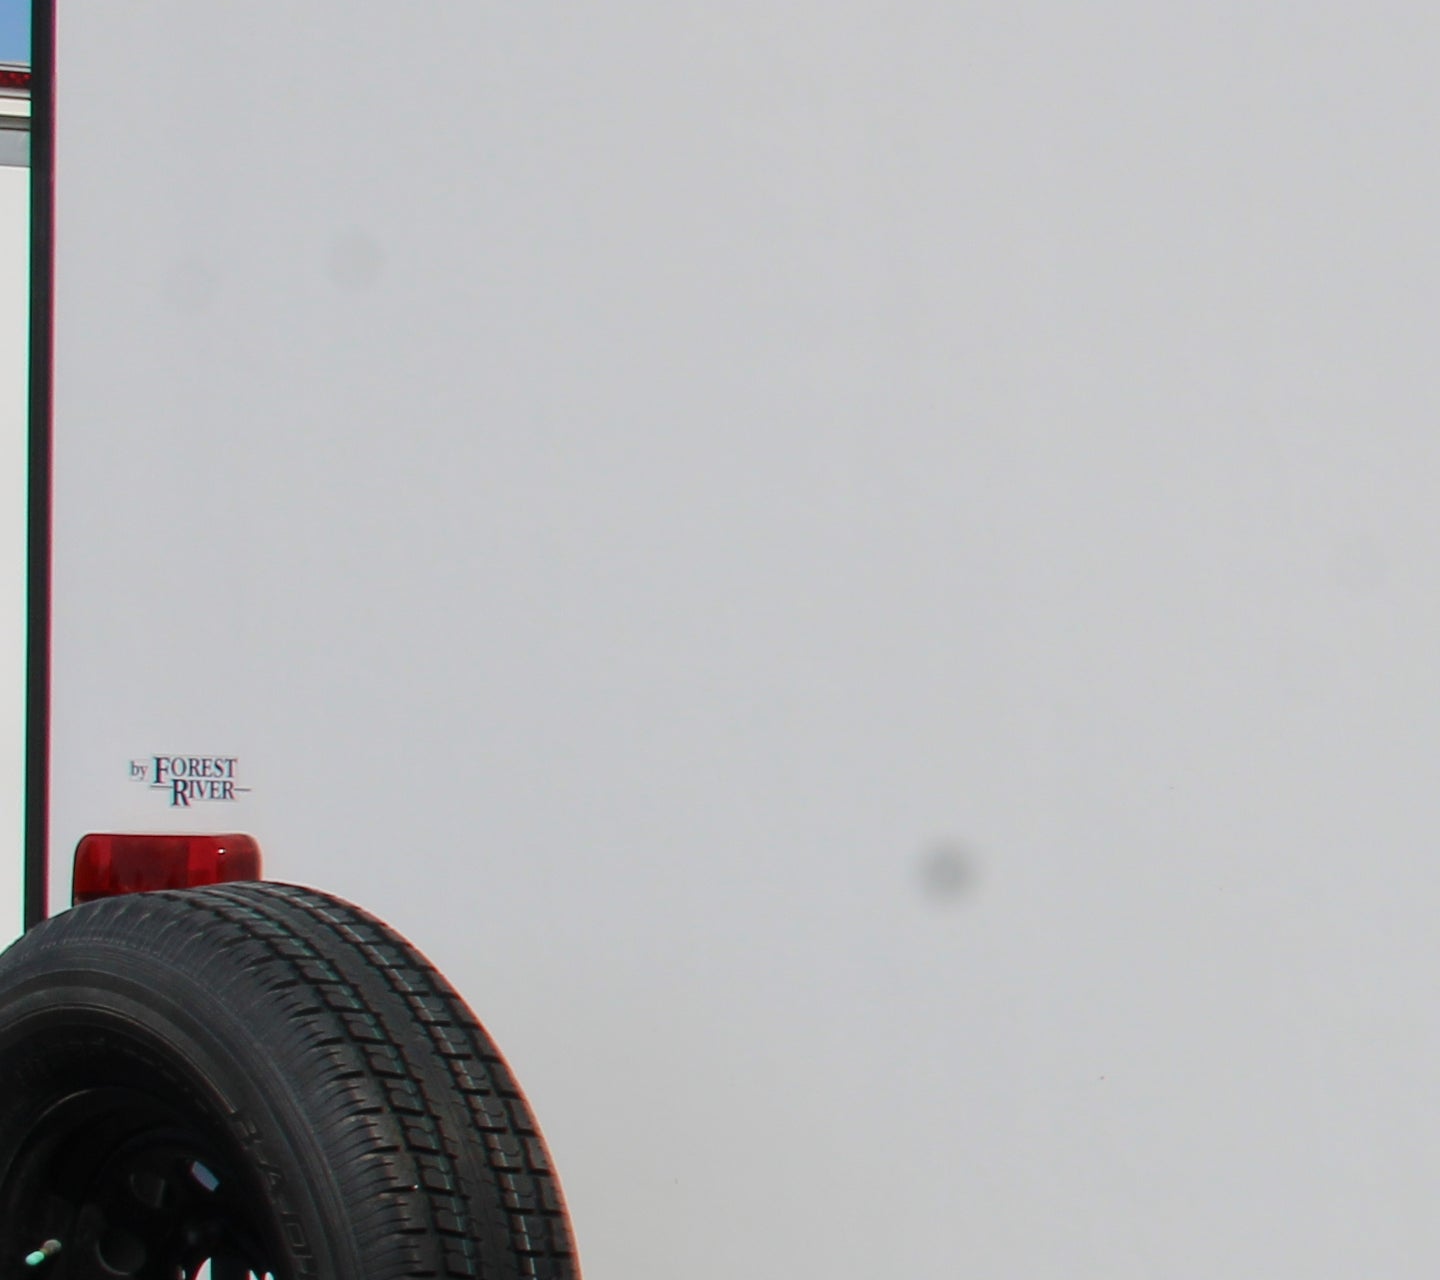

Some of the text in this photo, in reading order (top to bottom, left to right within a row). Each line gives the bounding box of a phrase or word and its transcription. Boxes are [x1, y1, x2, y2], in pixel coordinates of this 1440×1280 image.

[130, 756, 239, 784] by FOREST
[170, 778, 236, 807] RIVER
